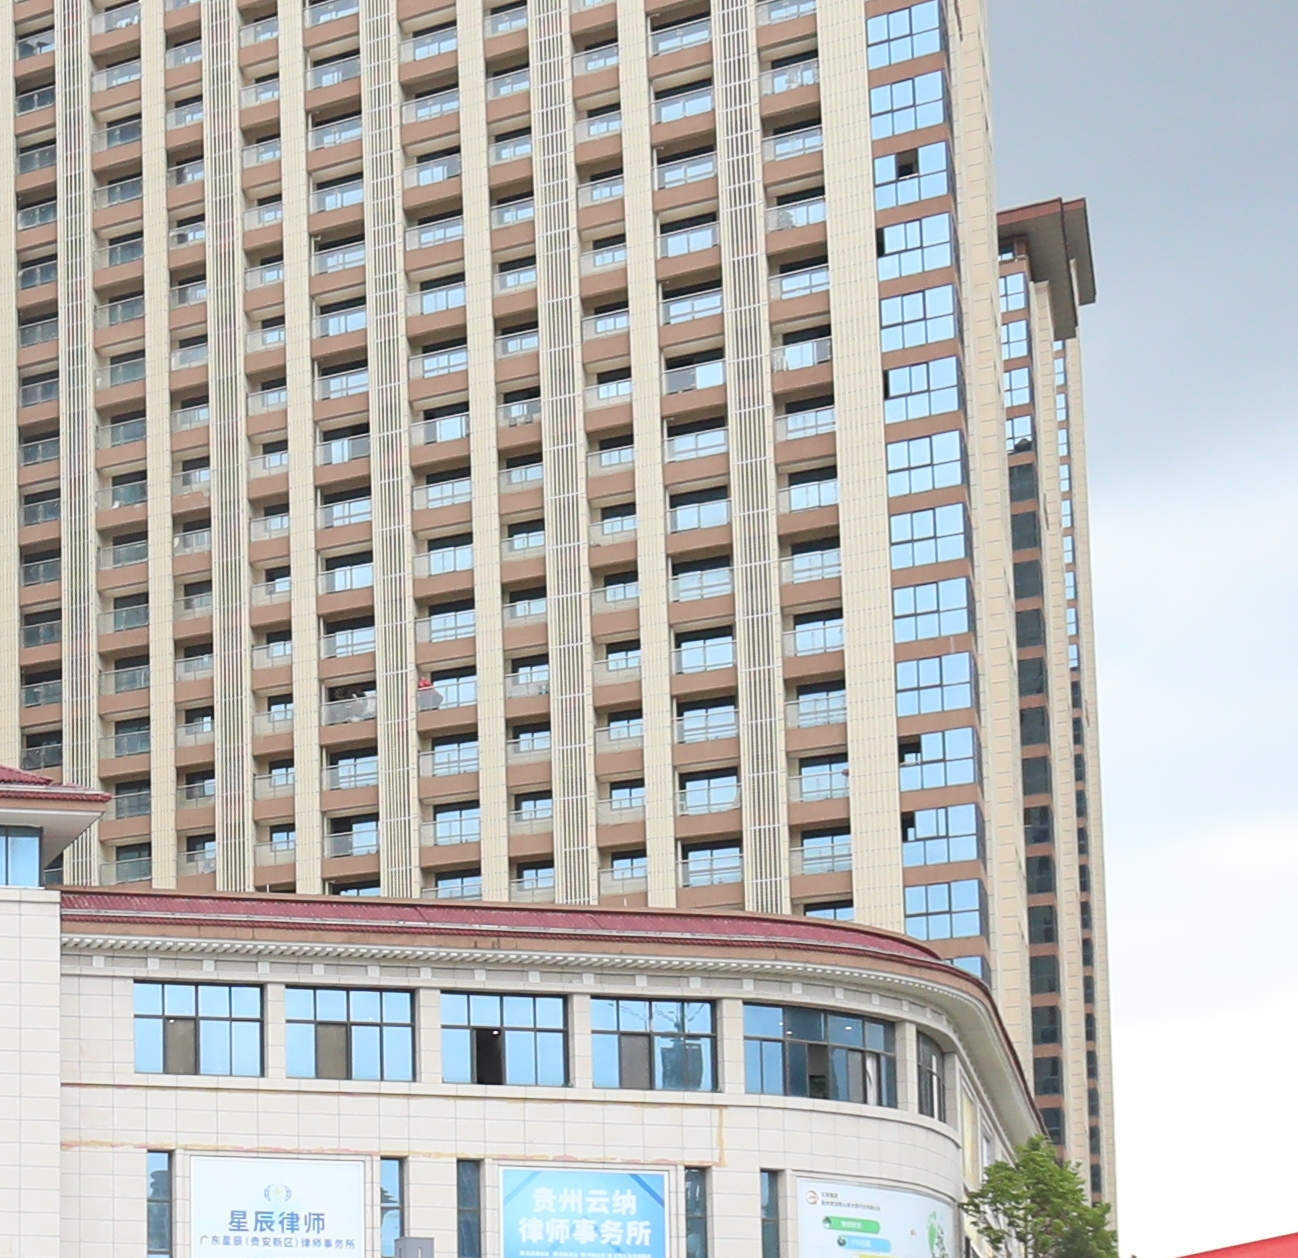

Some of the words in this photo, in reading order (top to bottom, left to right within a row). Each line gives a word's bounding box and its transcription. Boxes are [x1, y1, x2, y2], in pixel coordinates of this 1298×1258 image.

[532, 1187, 638, 1216] 贵州云纳
[228, 1210, 326, 1234] 星辰律师
[518, 1217, 652, 1247] 律师事务所
